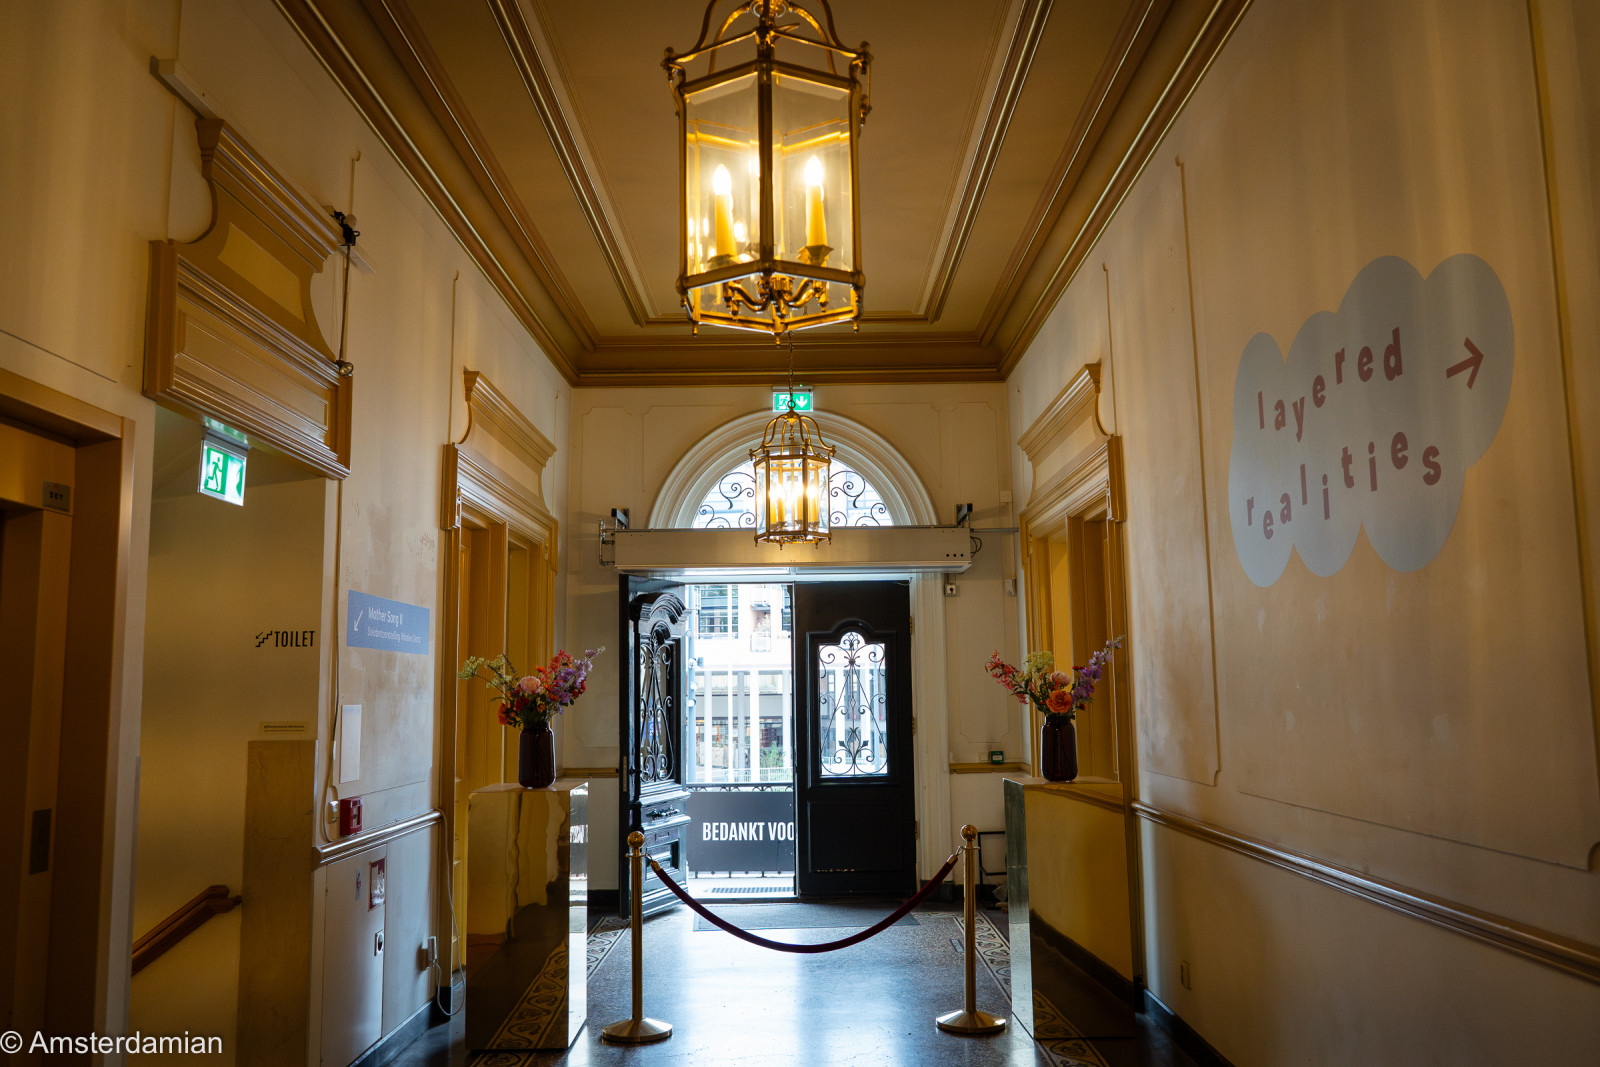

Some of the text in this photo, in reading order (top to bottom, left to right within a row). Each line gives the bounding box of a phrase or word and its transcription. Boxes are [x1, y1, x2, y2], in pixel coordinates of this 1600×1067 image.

[1257, 326, 1403, 443] layered
[1246, 431, 1442, 540] realities
[368, 606, 387, 622] Mother
[274, 631, 315, 648] TOILET
[702, 822, 765, 841] BEDANKT
